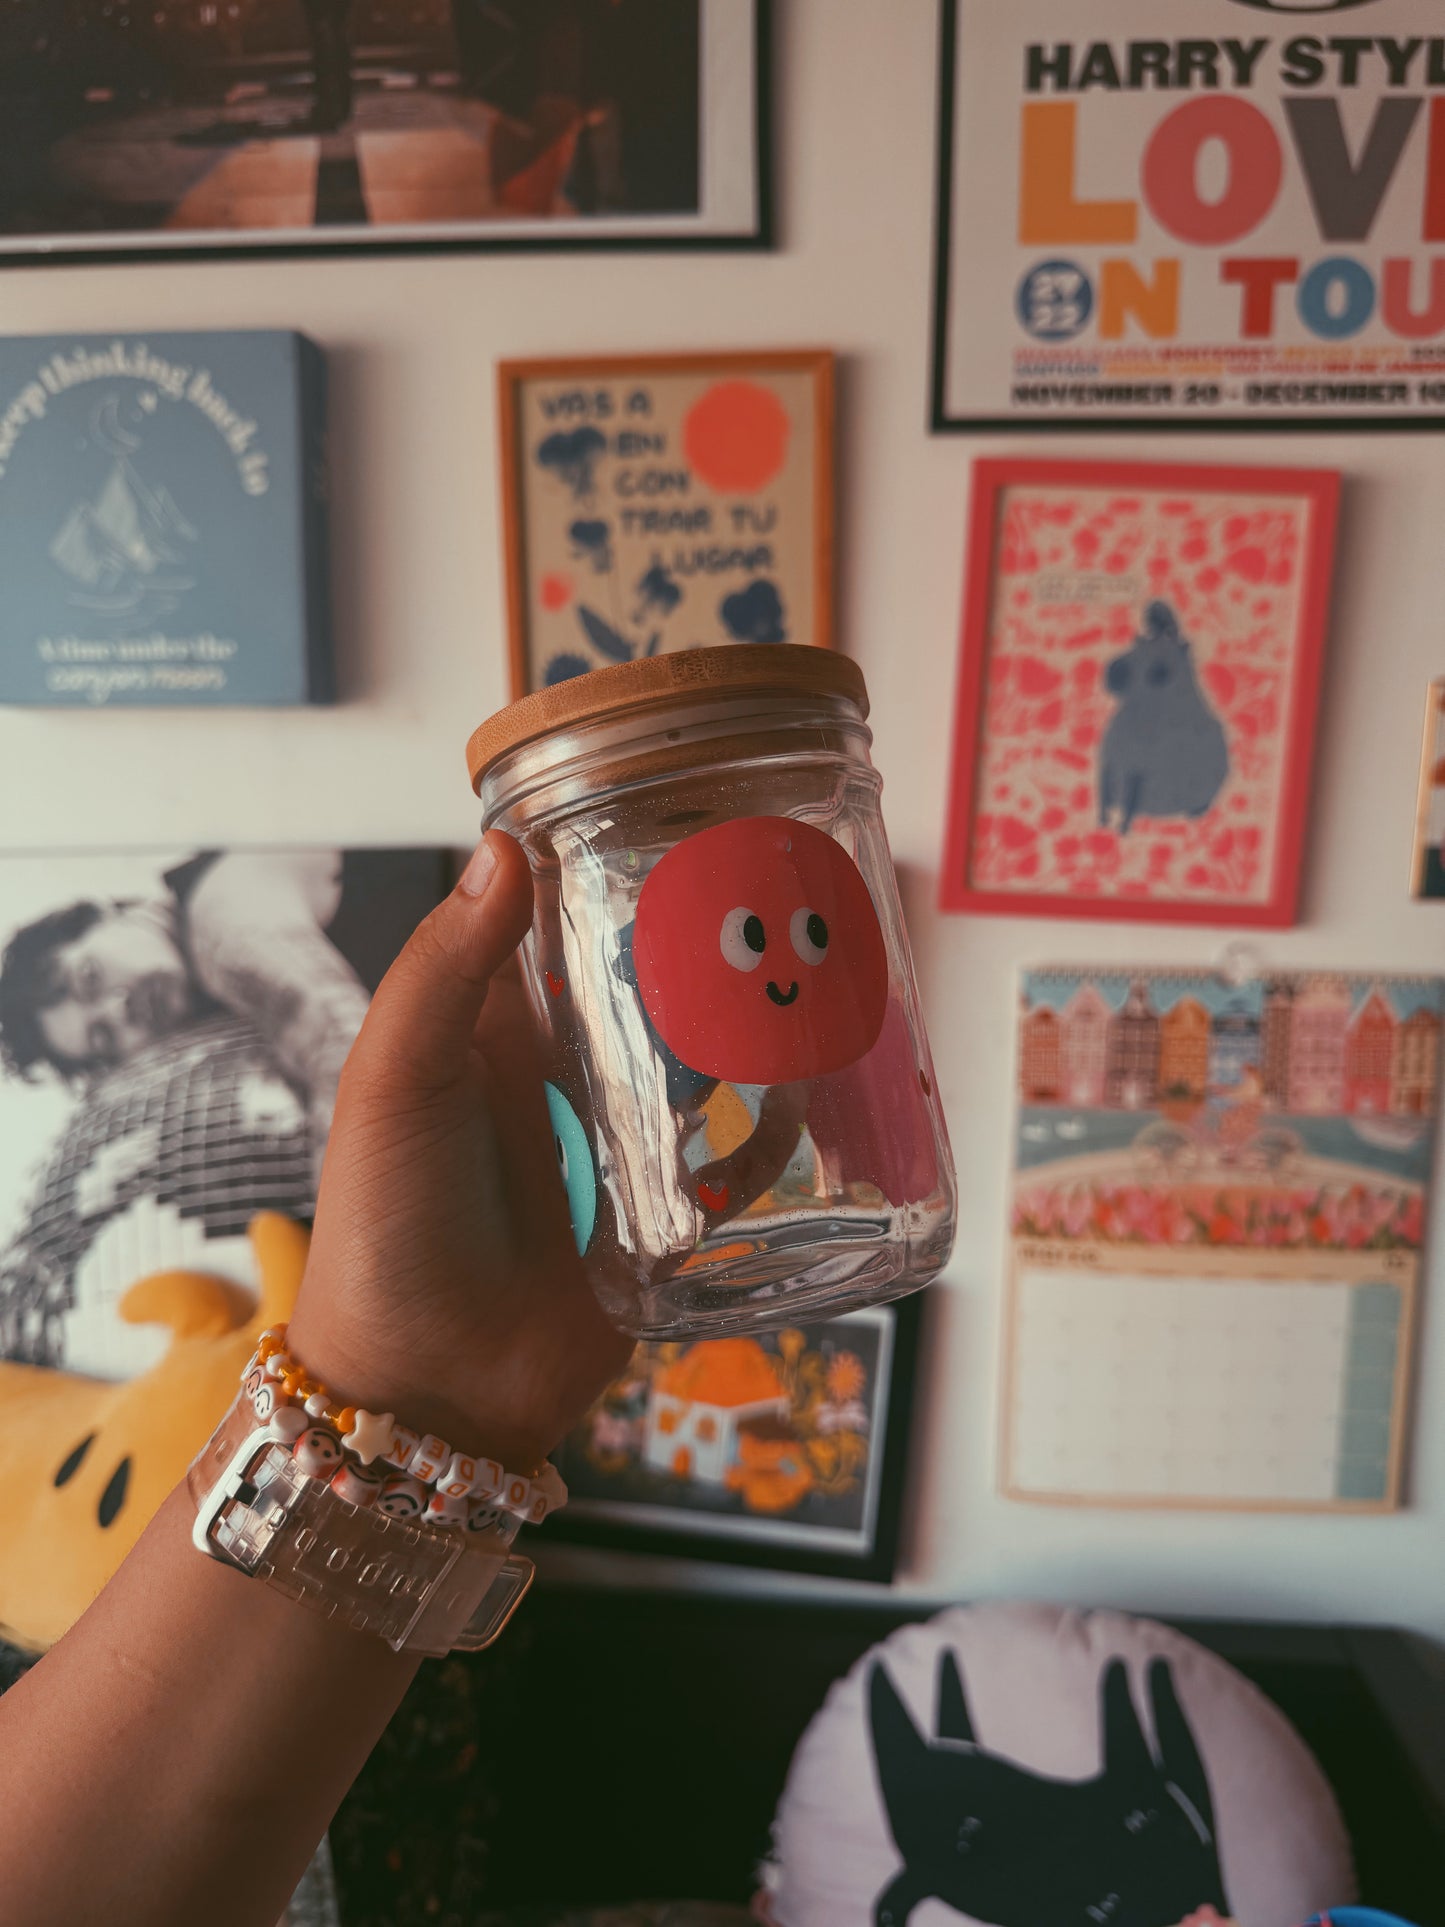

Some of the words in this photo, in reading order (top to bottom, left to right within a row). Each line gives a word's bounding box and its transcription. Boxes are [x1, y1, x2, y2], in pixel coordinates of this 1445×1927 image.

[1025, 36, 1269, 91] HARRY
[539, 389, 613, 419] VAS
[627, 388, 652, 417] A
[1013, 382, 1172, 407] NOVEMBER
[1184, 383, 1221, 406] 20
[1244, 381, 1409, 406] DECEMBER
[38, 340, 192, 399] thinking
[239, 450, 269, 496] to
[616, 430, 667, 458] EN
[614, 467, 691, 498] CON
[620, 505, 711, 537] TRAR
[730, 503, 778, 535] TU
